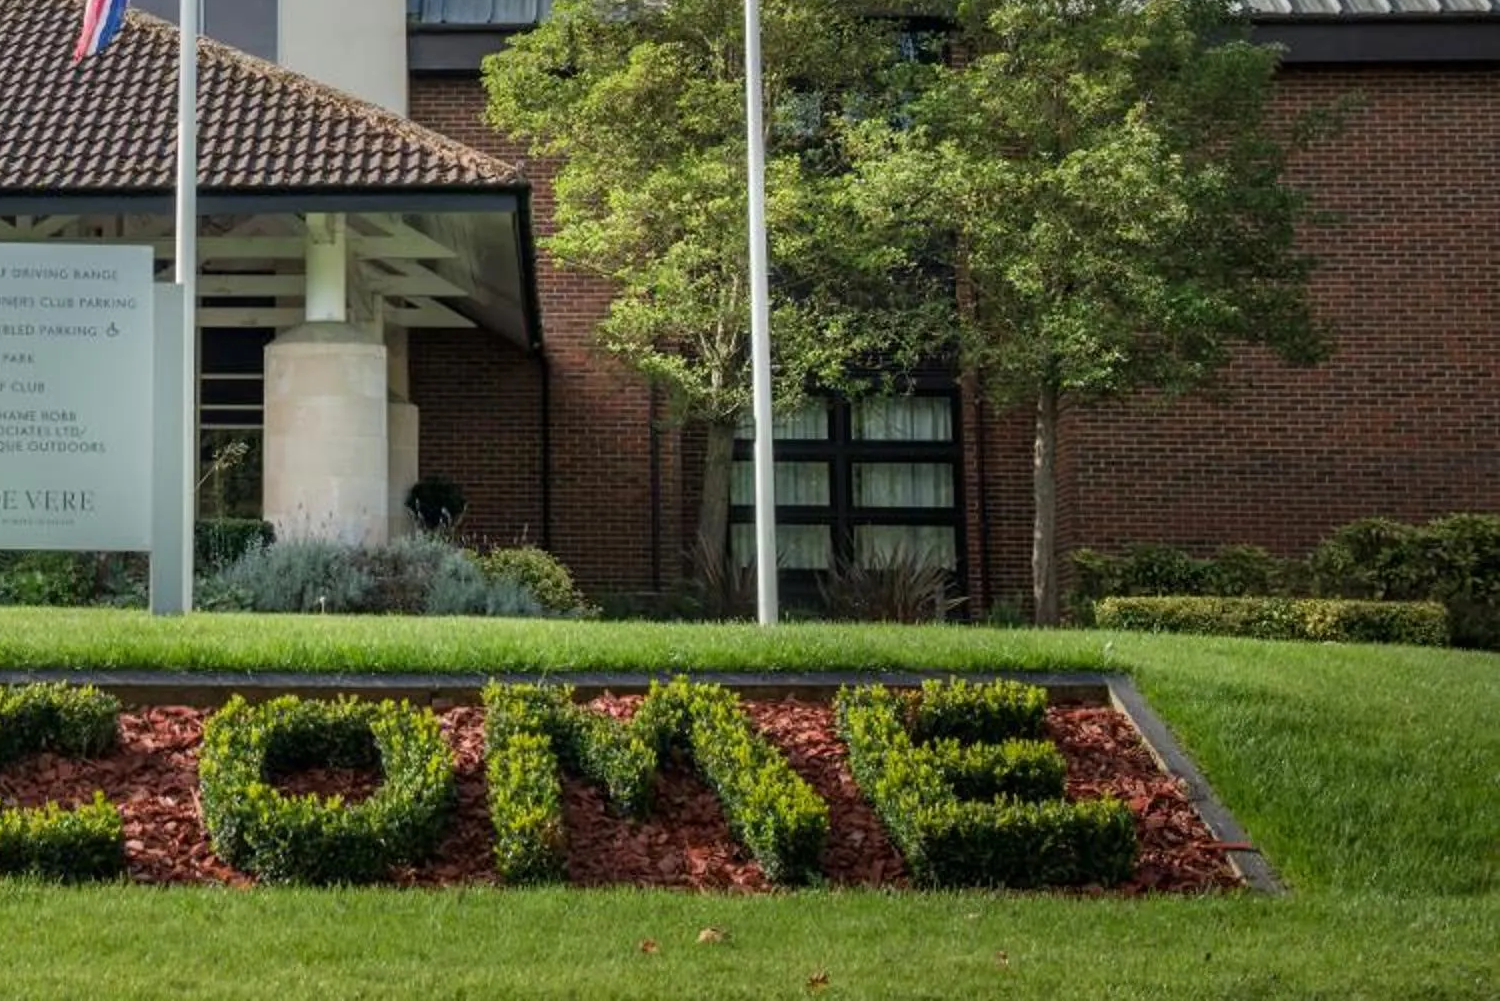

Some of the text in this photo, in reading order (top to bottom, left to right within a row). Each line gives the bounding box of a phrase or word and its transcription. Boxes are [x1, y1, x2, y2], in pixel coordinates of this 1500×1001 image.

[11, 267, 68, 280] DRIVING
[73, 268, 118, 281] RANGE
[39, 296, 74, 309] CLUB
[78, 297, 136, 310] PARKING
[39, 325, 97, 337] PARKING
[2, 352, 35, 364] PARK
[10, 381, 45, 393] CLUB
[27, 441, 106, 454] OUTDOORS
[25, 489, 96, 512] VERE
